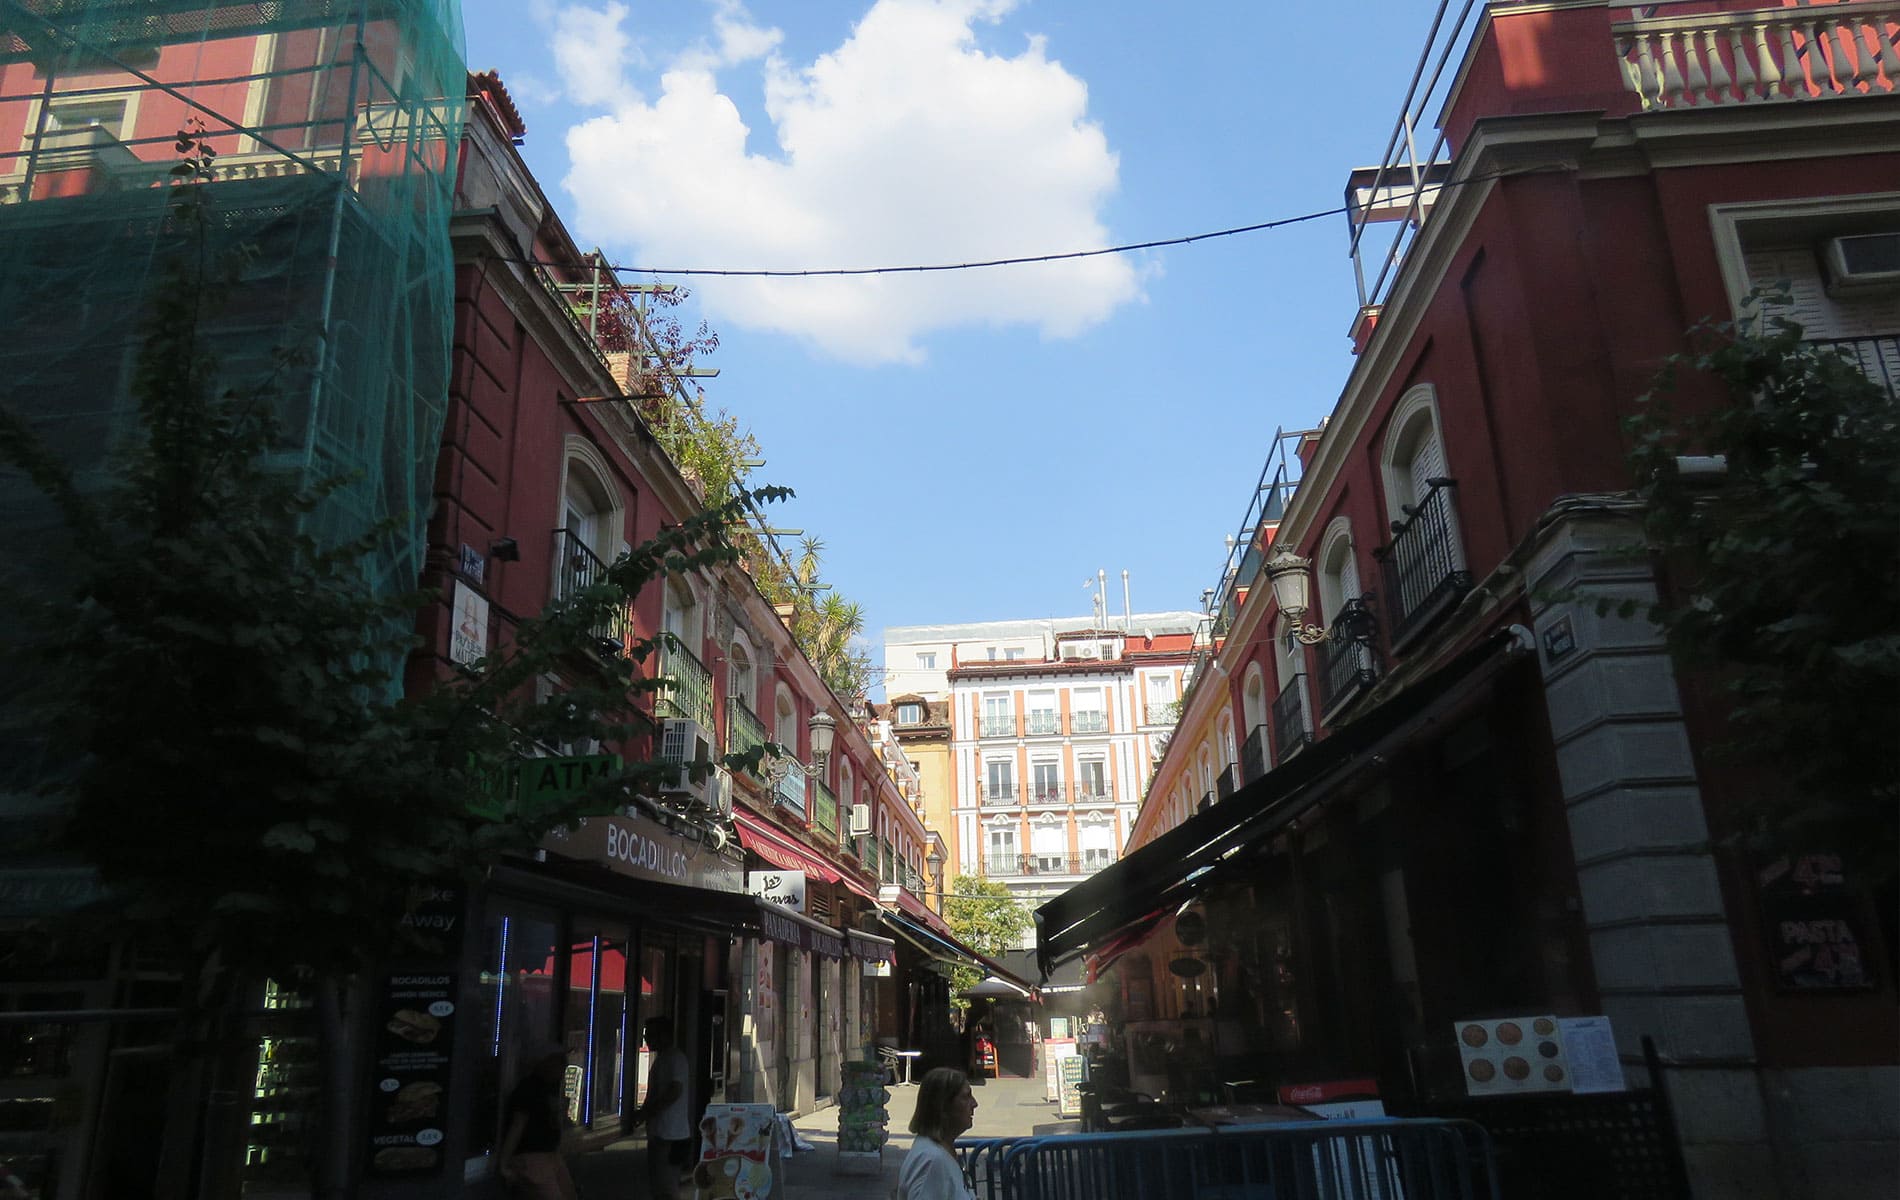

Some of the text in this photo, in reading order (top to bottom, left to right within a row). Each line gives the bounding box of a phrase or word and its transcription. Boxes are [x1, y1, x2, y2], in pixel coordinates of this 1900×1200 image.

[537, 760, 610, 791] ATM
[607, 823, 687, 879] BOCADILLOS
[763, 875, 782, 892] Las
[400, 911, 457, 932] Away
[1780, 919, 1856, 945] PASTA
[373, 1135, 416, 1147] VEGETAL
